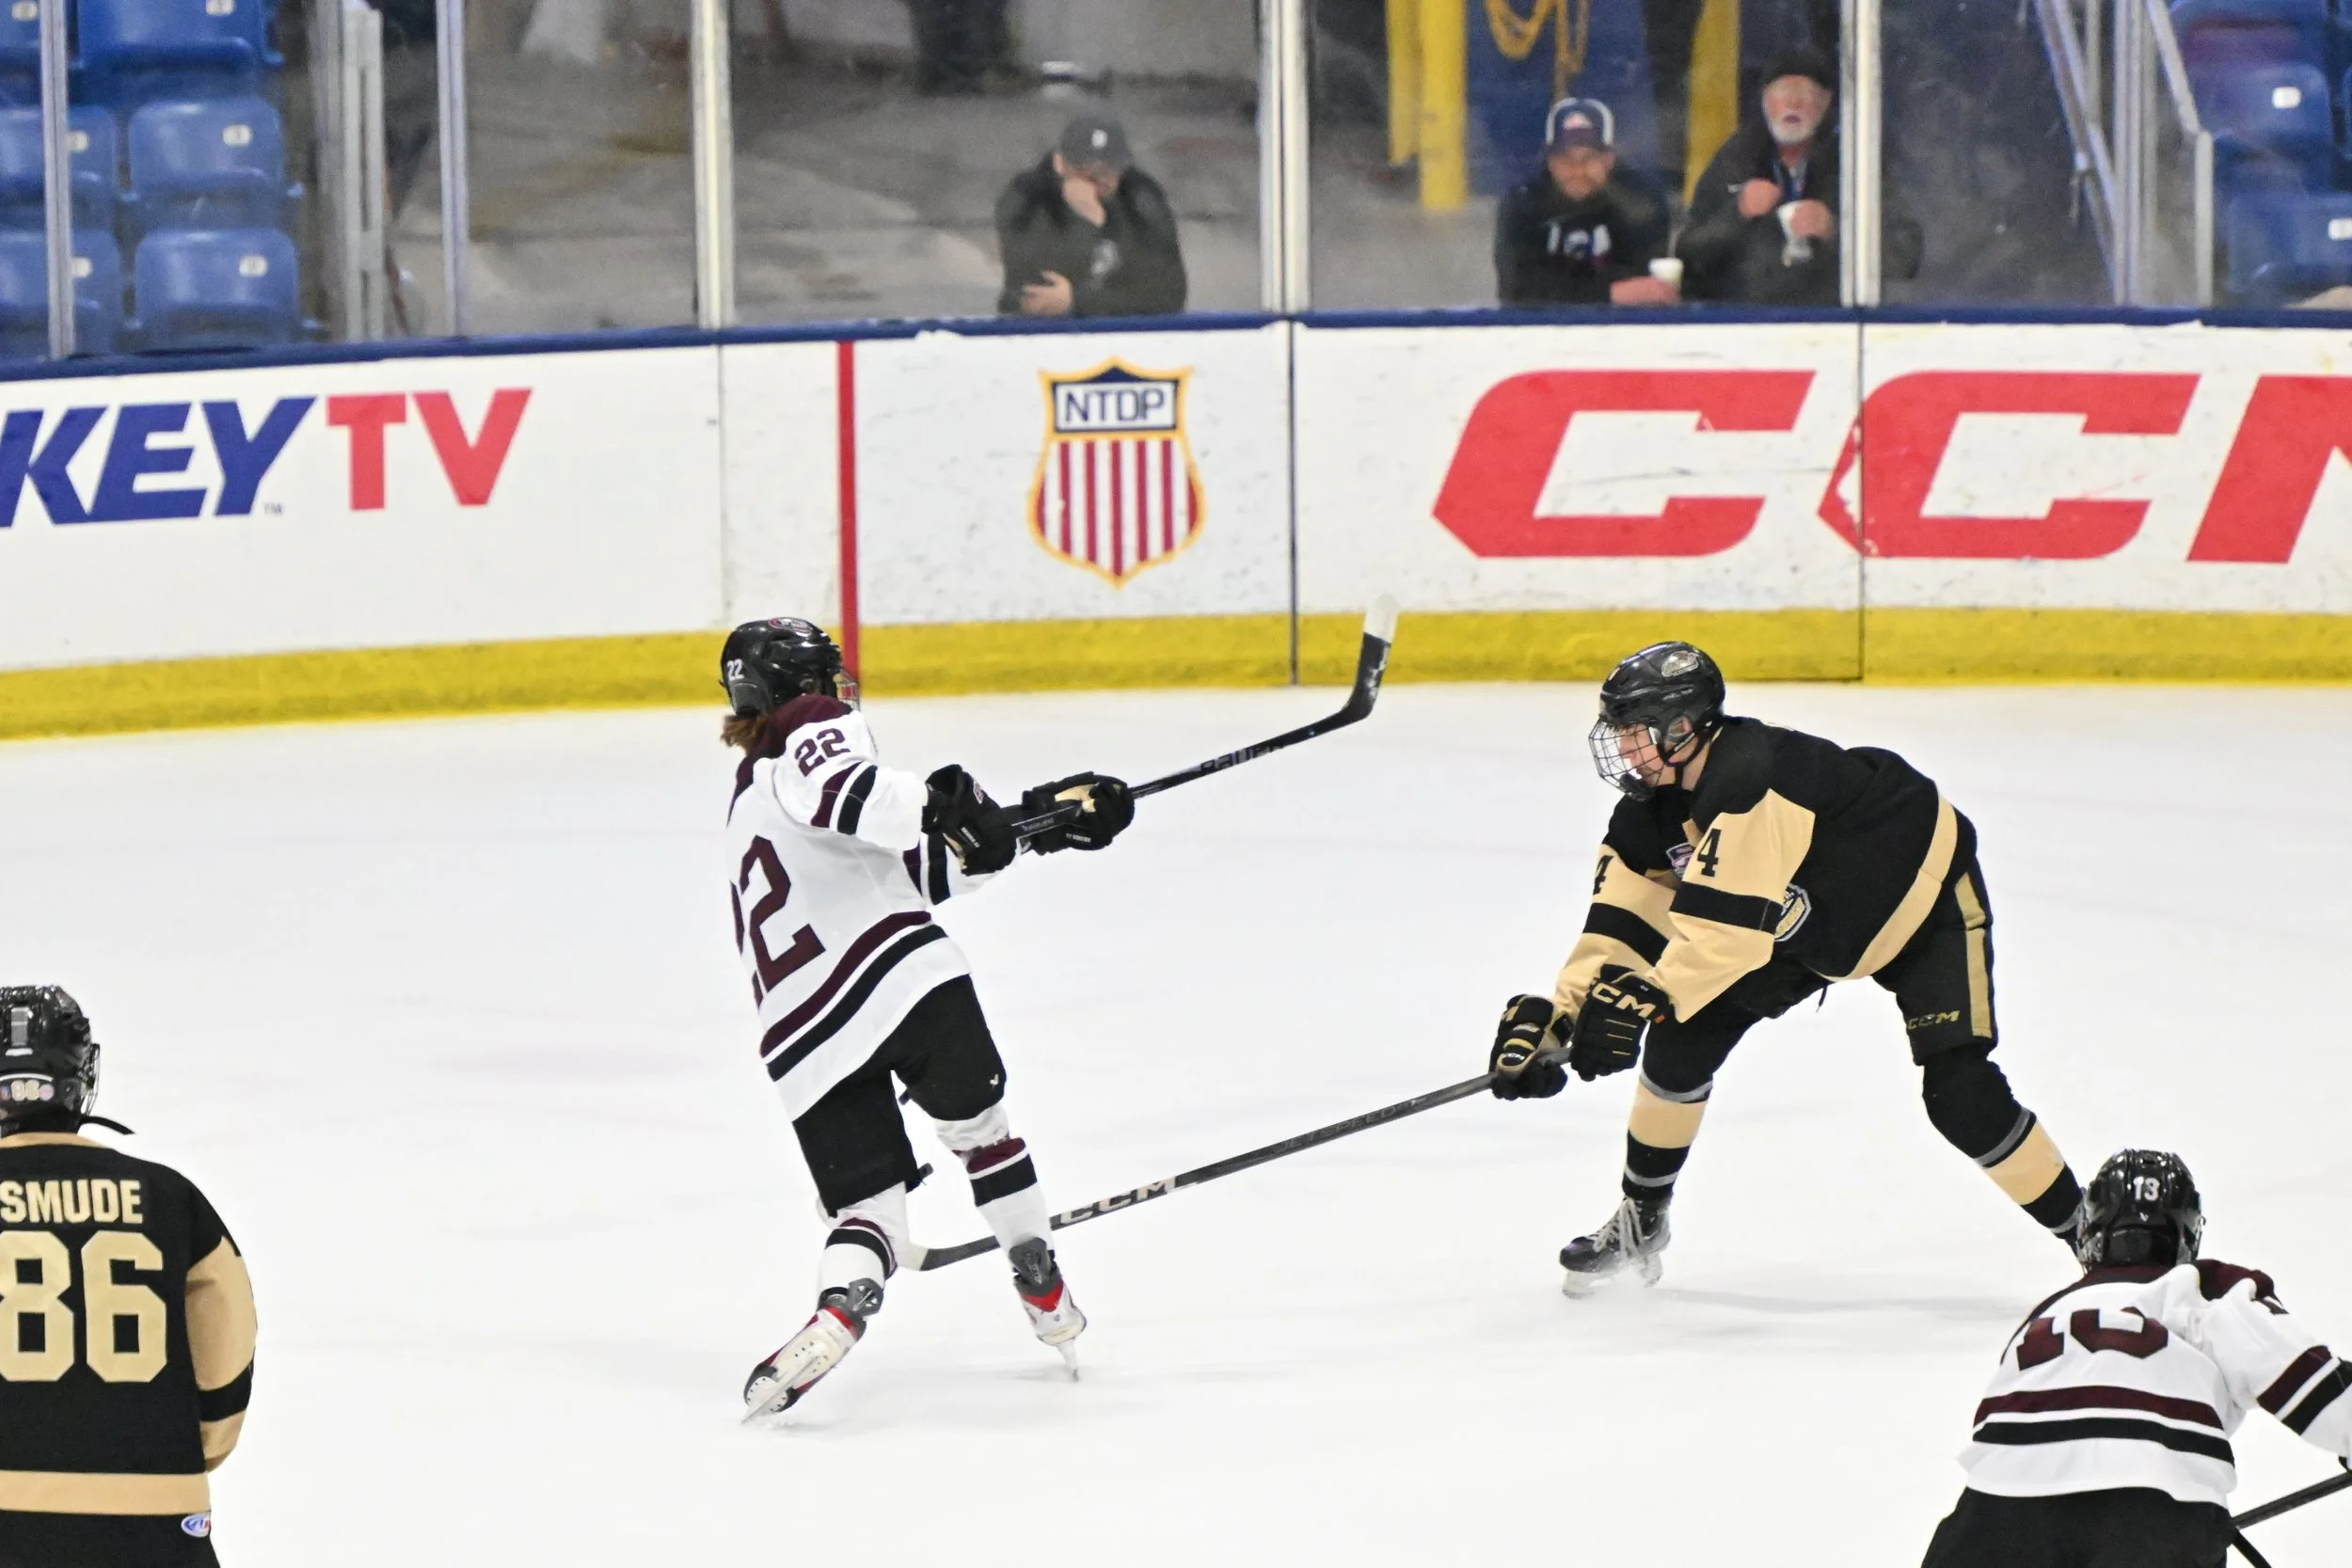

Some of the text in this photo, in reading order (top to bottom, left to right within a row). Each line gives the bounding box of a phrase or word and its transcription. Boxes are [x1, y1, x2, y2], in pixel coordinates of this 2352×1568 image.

[1065, 387, 1165, 422] NTDP
[727, 658, 745, 681] 22
[794, 727, 851, 778] 22
[1697, 828, 1723, 878] 4
[1589, 979, 1657, 1019] CM
[1907, 1009, 1961, 1030] CCM
[0, 1179, 143, 1224] SMUDE
[1059, 1175, 1176, 1225] CCM
[2133, 1176, 2161, 1202] 13
[0, 1229, 167, 1383] 86
